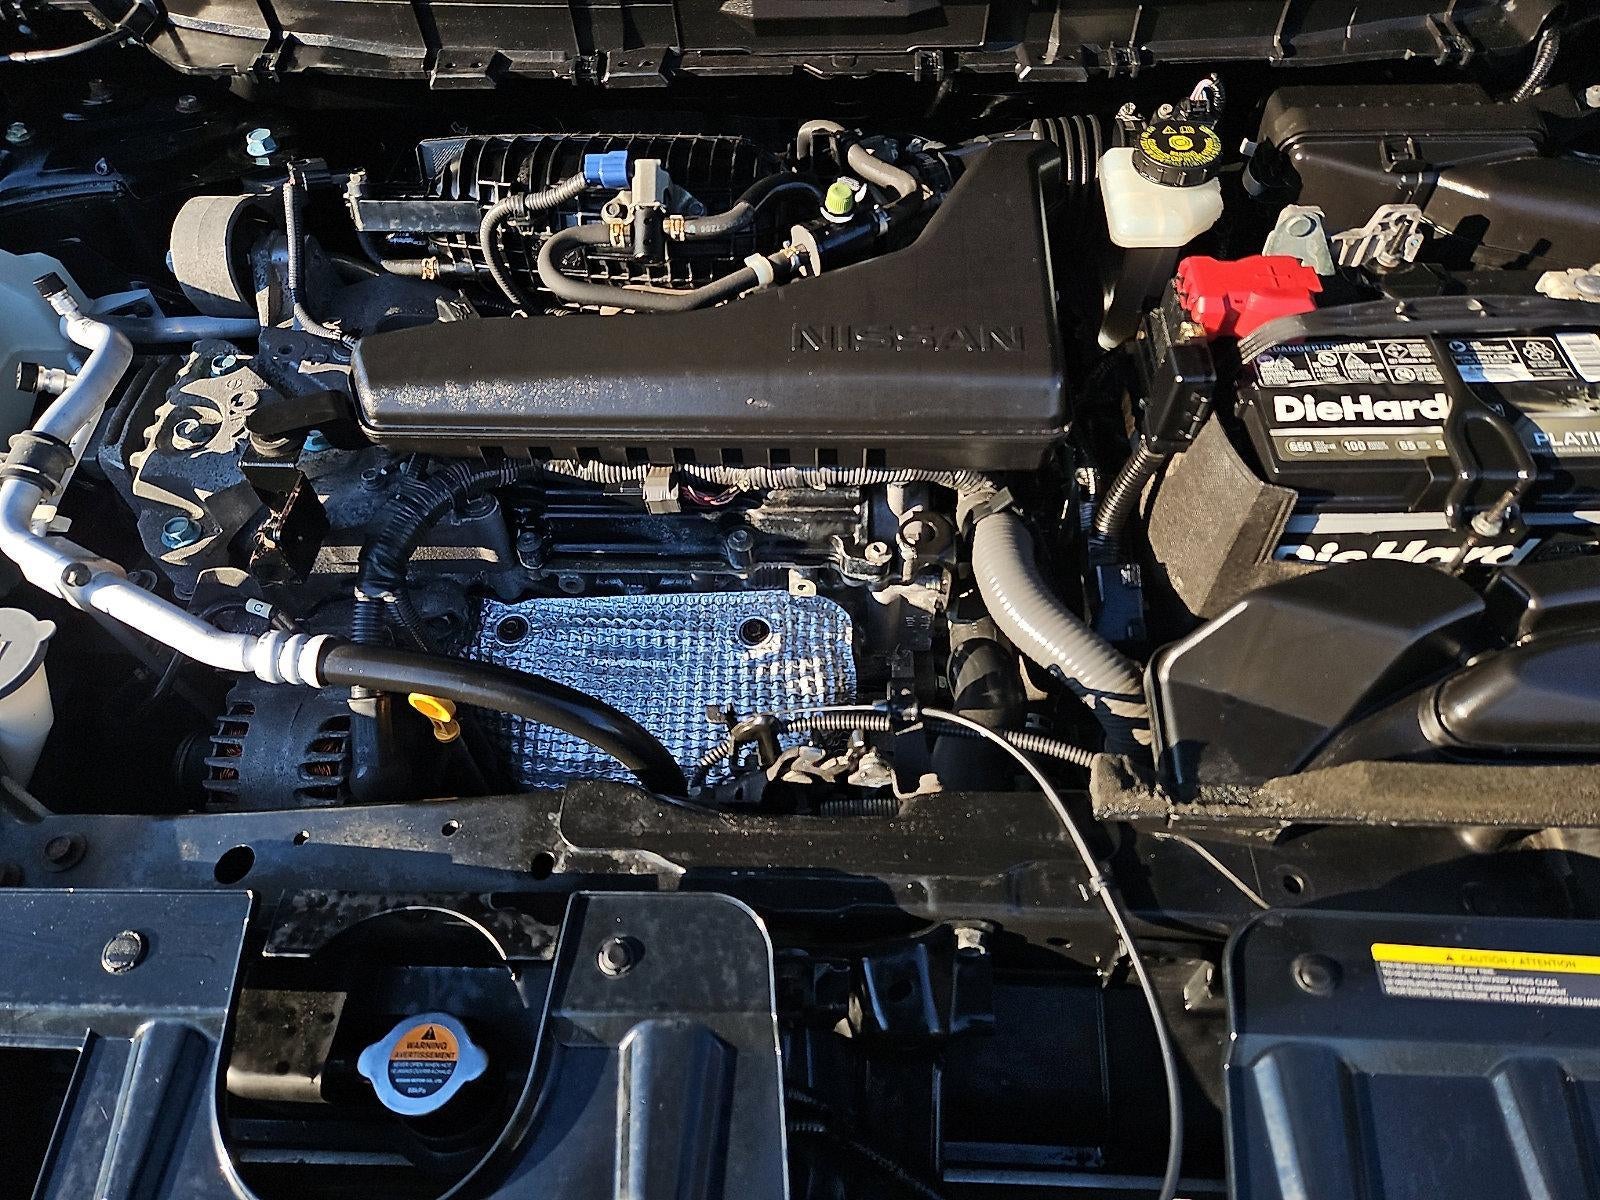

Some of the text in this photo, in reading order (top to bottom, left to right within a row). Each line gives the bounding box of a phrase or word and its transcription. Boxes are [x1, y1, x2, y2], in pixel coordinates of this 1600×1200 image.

[791, 324, 1025, 352] NISSAN
[1273, 392, 1450, 422] DieHard
[1533, 431, 1600, 446] PLATI
[1344, 441, 1367, 452] 100
[1461, 954, 1508, 965] CAUTION
[1519, 957, 1576, 969] ATTENTION
[407, 1041, 448, 1050] WARNING
